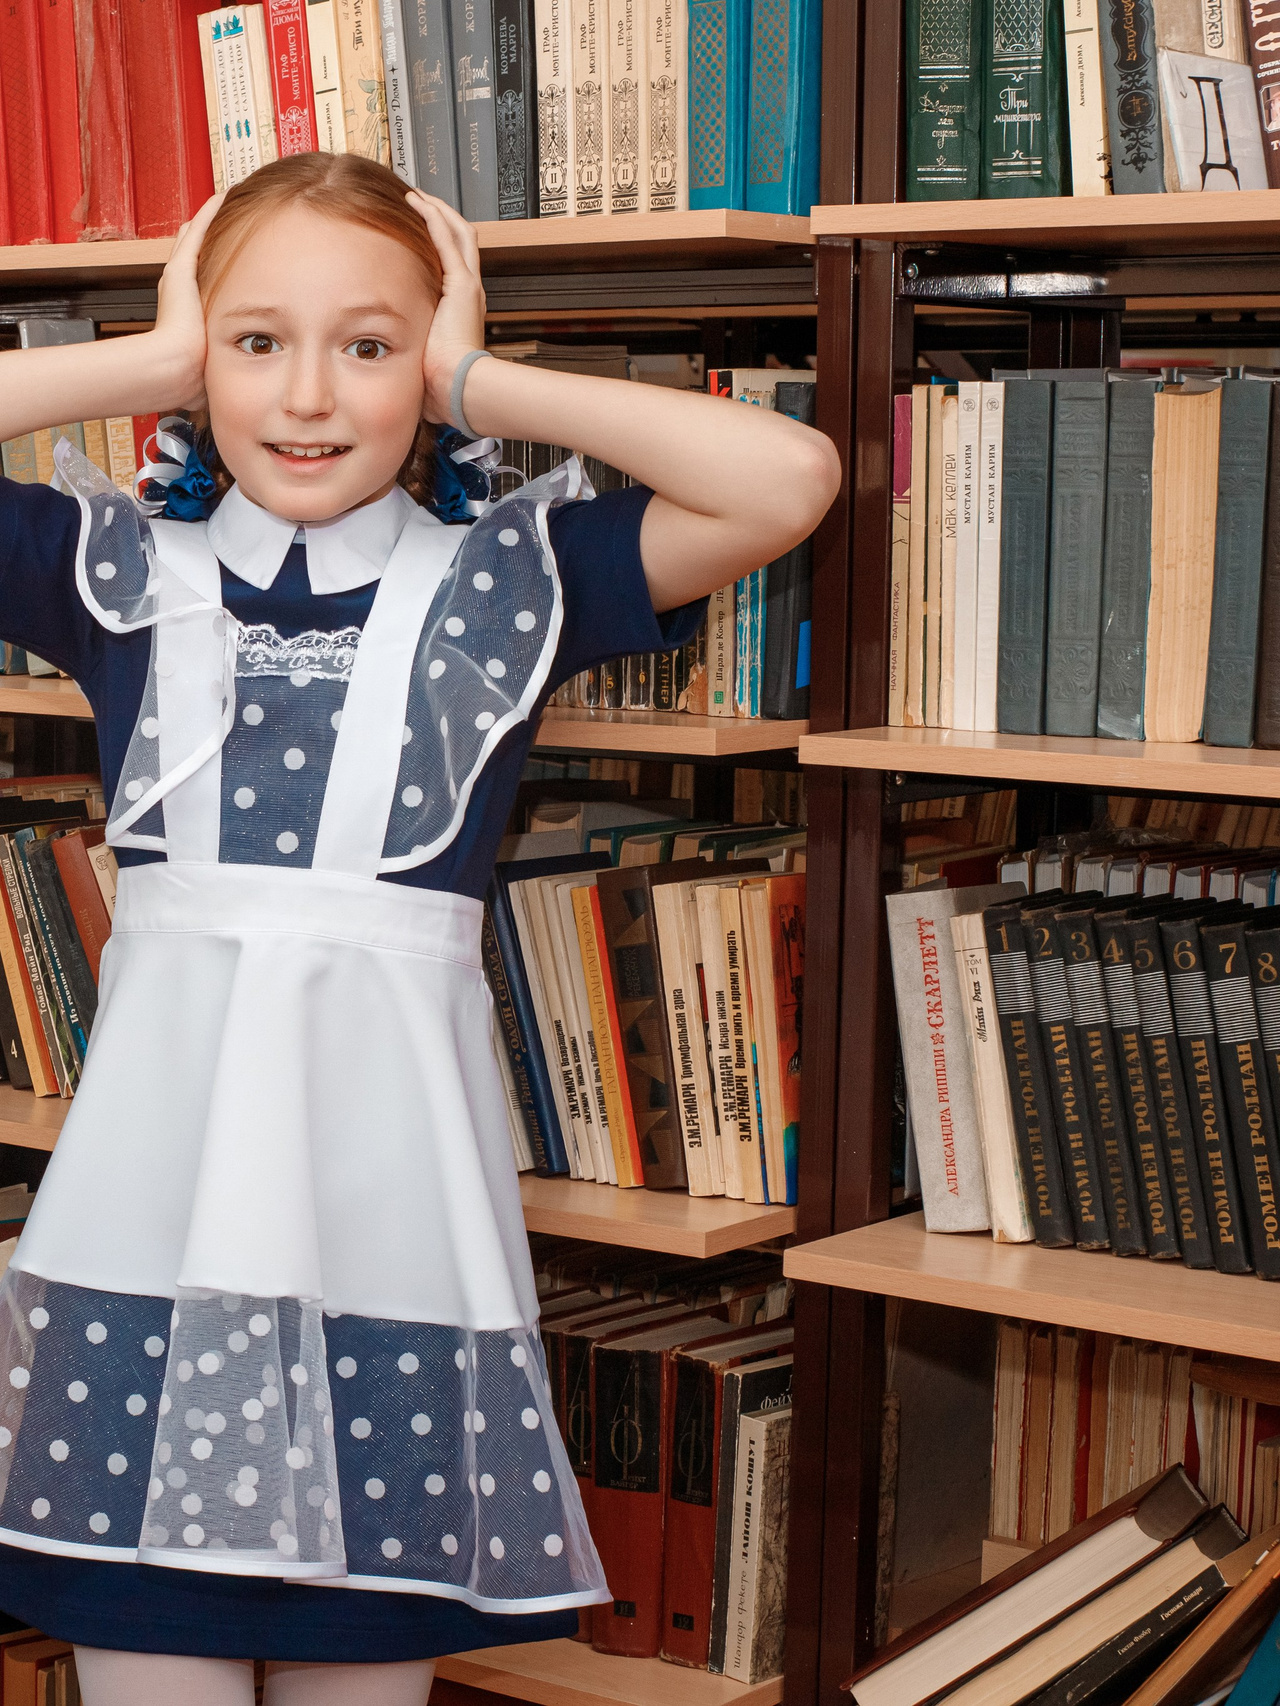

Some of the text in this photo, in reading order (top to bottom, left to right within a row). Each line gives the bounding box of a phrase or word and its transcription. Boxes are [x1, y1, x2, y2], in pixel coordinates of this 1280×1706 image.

[273, 13, 300, 26] ДЮМА
[508, 24, 517, 63] МАРГО
[542, 27, 550, 54] ГРАФ
[579, 24, 587, 50] ГРАФ
[655, 17, 663, 44] ГРАФ
[280, 54, 289, 78] ГРАФ
[287, 26, 300, 100] МОНТЕ-КРИСТО
[499, 17, 508, 74] КОРОЛЕВА
[216, 49, 229, 116] САЛЬТЕАДОР
[237, 44, 249, 112] САЛЬТЕАДОР
[999, 85, 1029, 114] Три
[1076, 44, 1086, 107] Александр ДЮМА
[390, 78, 408, 177] Александр Дюма
[426, 125, 437, 175] АМОРИ
[469, 122, 480, 173] АМОРИ
[1187, 75, 1241, 191] Д
[963, 444, 972, 524] МУСТАЙ КАРИМ
[987, 444, 996, 524] МУСТАЙ КАРИМ
[715, 611, 726, 681] Шарль де Костер
[890, 581, 901, 691] НАУЧНАЯ ФАНТАСТИКА
[1, 858, 16, 887] СТРЕЛКИ
[10, 887, 24, 919] ВОЛЬНЫЕ
[22, 933, 34, 952] Рид
[1034, 926, 1053, 957] 2
[1173, 941, 1196, 970] 6
[1219, 942, 1237, 973] 7
[28, 955, 40, 981] Майн
[488, 952, 508, 1000] СРЕДИ
[34, 984, 48, 1015] Томас
[713, 990, 730, 1050] Искра жизни
[501, 1006, 520, 1049] ОДИН
[553, 1019, 572, 1067] Возвращение
[726, 930, 752, 1142] Э.М.РЕМАРК Время жить умирать
[672, 988, 702, 1148] Э.М.РЕМАРК Триумфальная арка
[917, 917, 959, 1196] АЛЕКСАНДРА РИППЛИ СКАРЛЕТТ
[526, 1110, 549, 1169] Мариан
[1009, 1019, 1052, 1217] РОМЕН РОЛЛАН
[1122, 1032, 1167, 1236] РОМЕН РОЛЛАН
[1190, 1039, 1234, 1243] РОМЕН РОЛЛАН
[734, 1437, 757, 1669] Шандор Фекете ЛАЙОШ КОШУТ
[1160, 1586, 1203, 1621] Госпожа Бовари
[1133, 1627, 1152, 1643] Флобер
